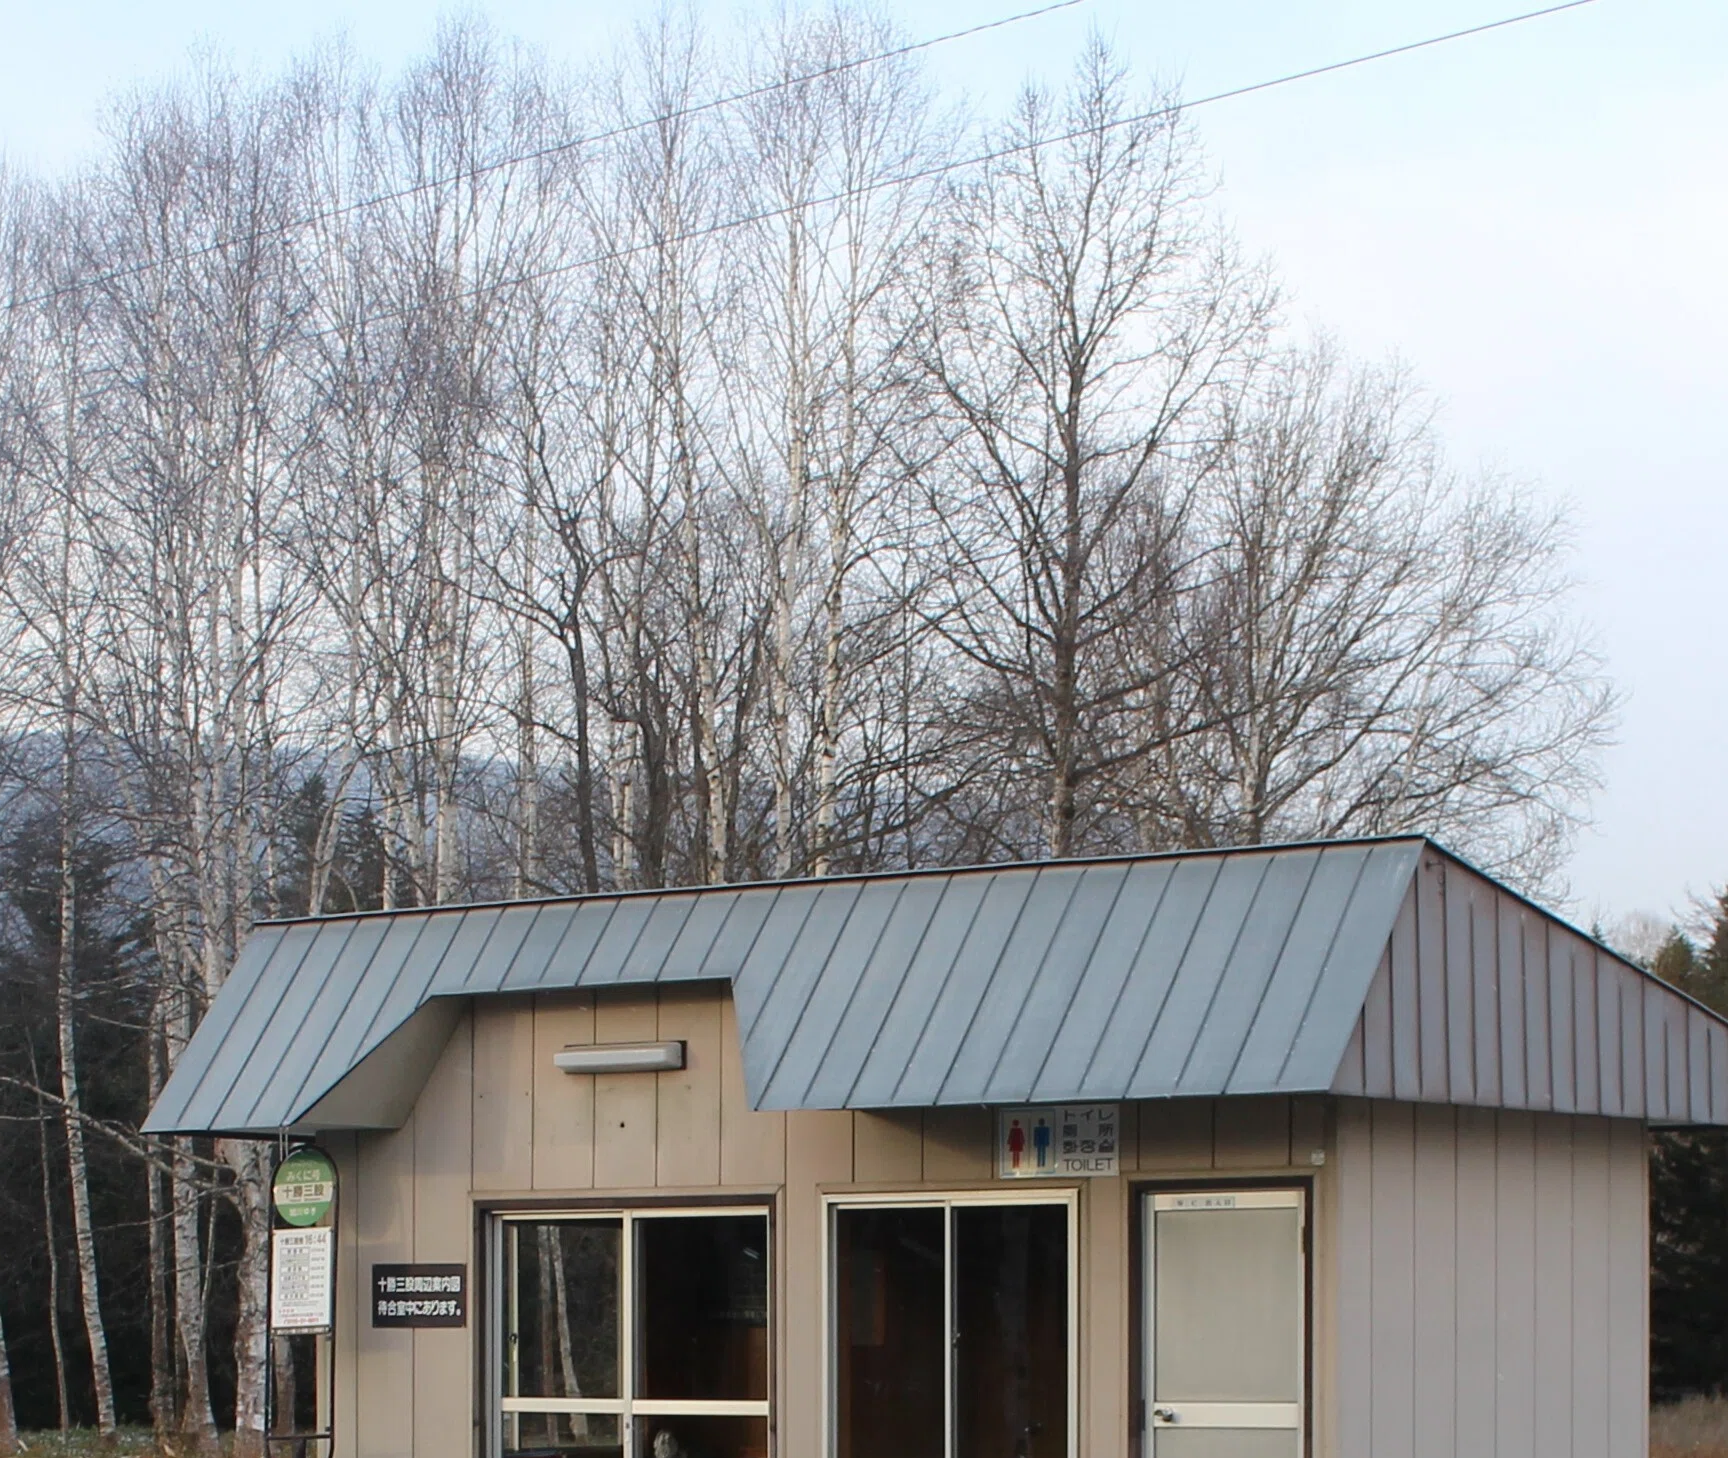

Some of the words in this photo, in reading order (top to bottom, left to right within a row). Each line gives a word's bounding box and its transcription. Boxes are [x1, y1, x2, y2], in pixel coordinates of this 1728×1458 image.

[1064, 1109, 1114, 1122] トイレ
[1063, 1157, 1114, 1171] TOILET
